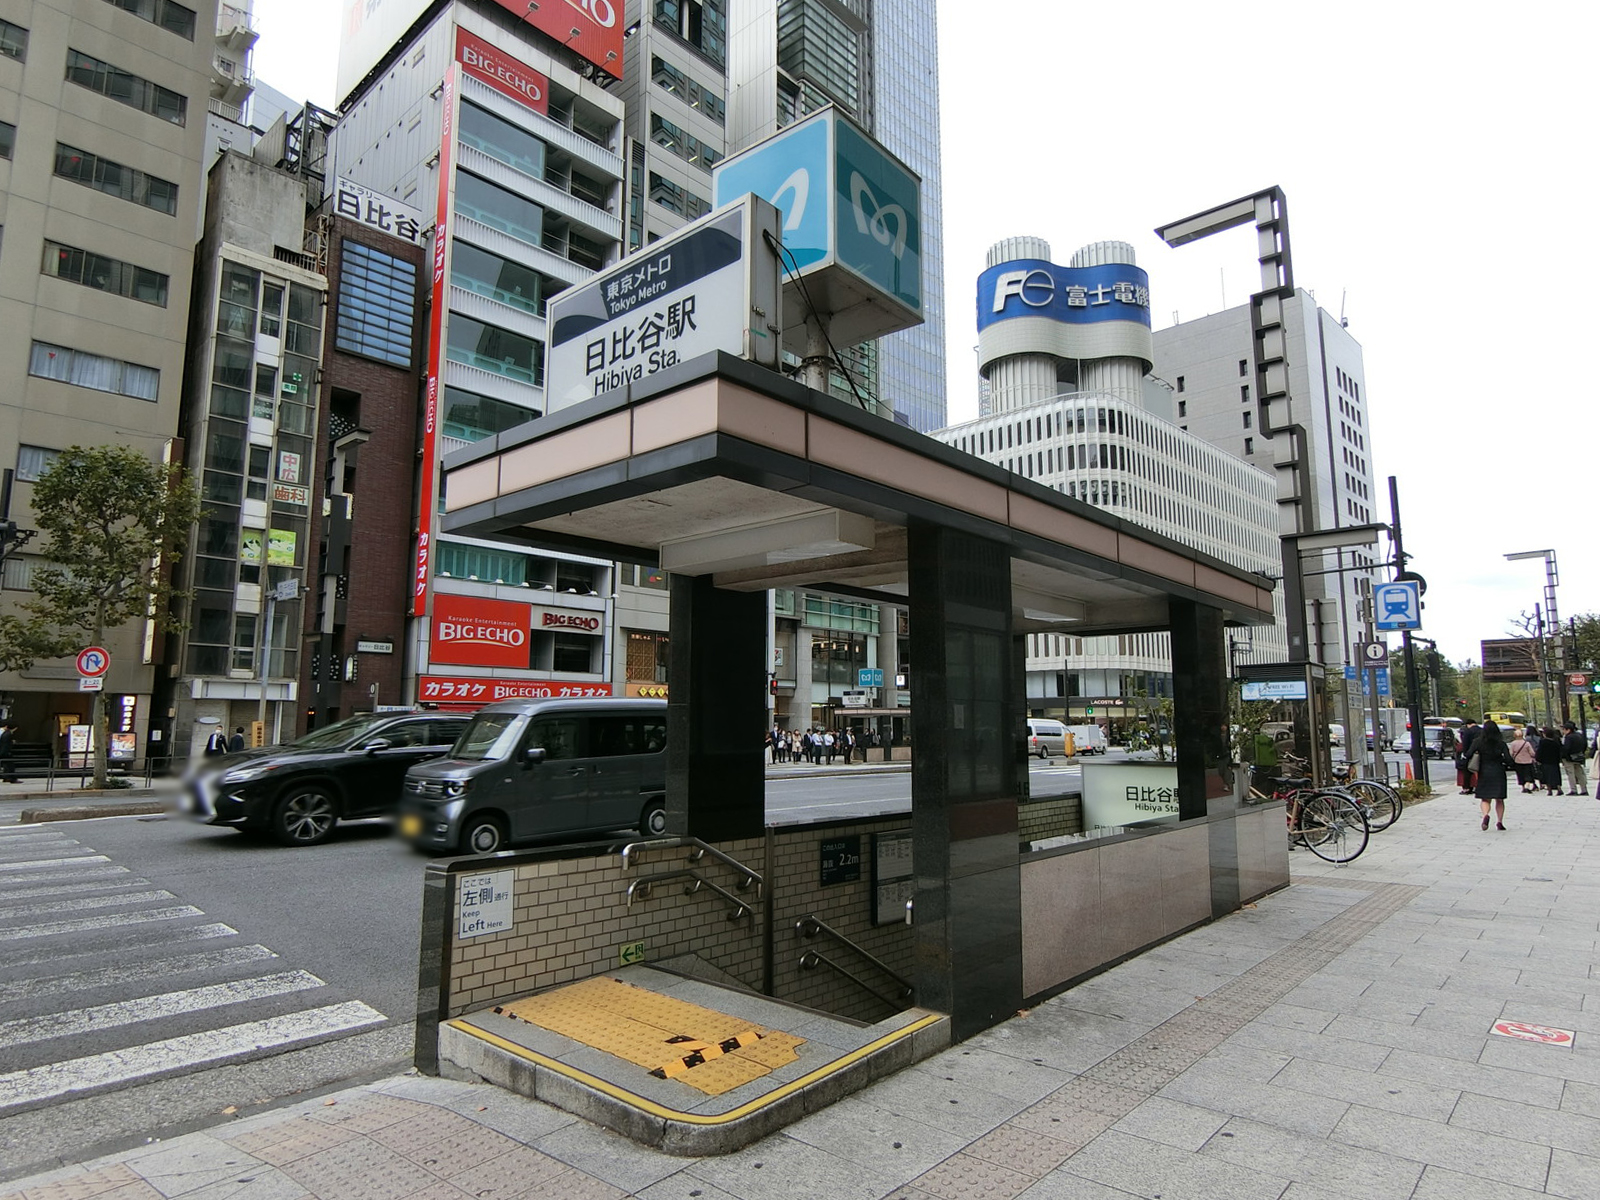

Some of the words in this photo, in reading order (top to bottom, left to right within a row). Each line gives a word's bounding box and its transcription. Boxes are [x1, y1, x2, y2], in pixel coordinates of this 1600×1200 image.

[463, 46, 494, 73] BIG
[497, 66, 541, 101] ECHO
[338, 189, 419, 242] 日比谷
[435, 224, 446, 283] カラオケ
[606, 254, 671, 301] 東京メトロ
[610, 295, 636, 315] Tokyo
[638, 280, 667, 299] Metro
[1065, 282, 1150, 307] 富士電機
[586, 294, 697, 376] 日比谷駅
[594, 363, 642, 396] Hibiya
[648, 350, 681, 374] Sta.
[282, 454, 297, 481] 中広
[274, 485, 306, 504] 歯科
[417, 532, 429, 597] カラオケ
[448, 615, 473, 624] Karaoke
[474, 617, 517, 627] Entertainment
[542, 612, 565, 627] BIG
[567, 616, 599, 630] ECHO
[439, 622, 474, 641] BIG
[477, 627, 525, 646] ECHO
[425, 681, 486, 697] カラオケ
[494, 685, 517, 699] BIG
[519, 687, 551, 698] ECHO
[1135, 803, 1162, 813] Hibiya
[840, 853, 859, 866] 2.2m
[463, 877, 491, 888] ここでは
[462, 910, 480, 918] Keep
[462, 919, 485, 933] Left
[487, 921, 503, 929] Here
